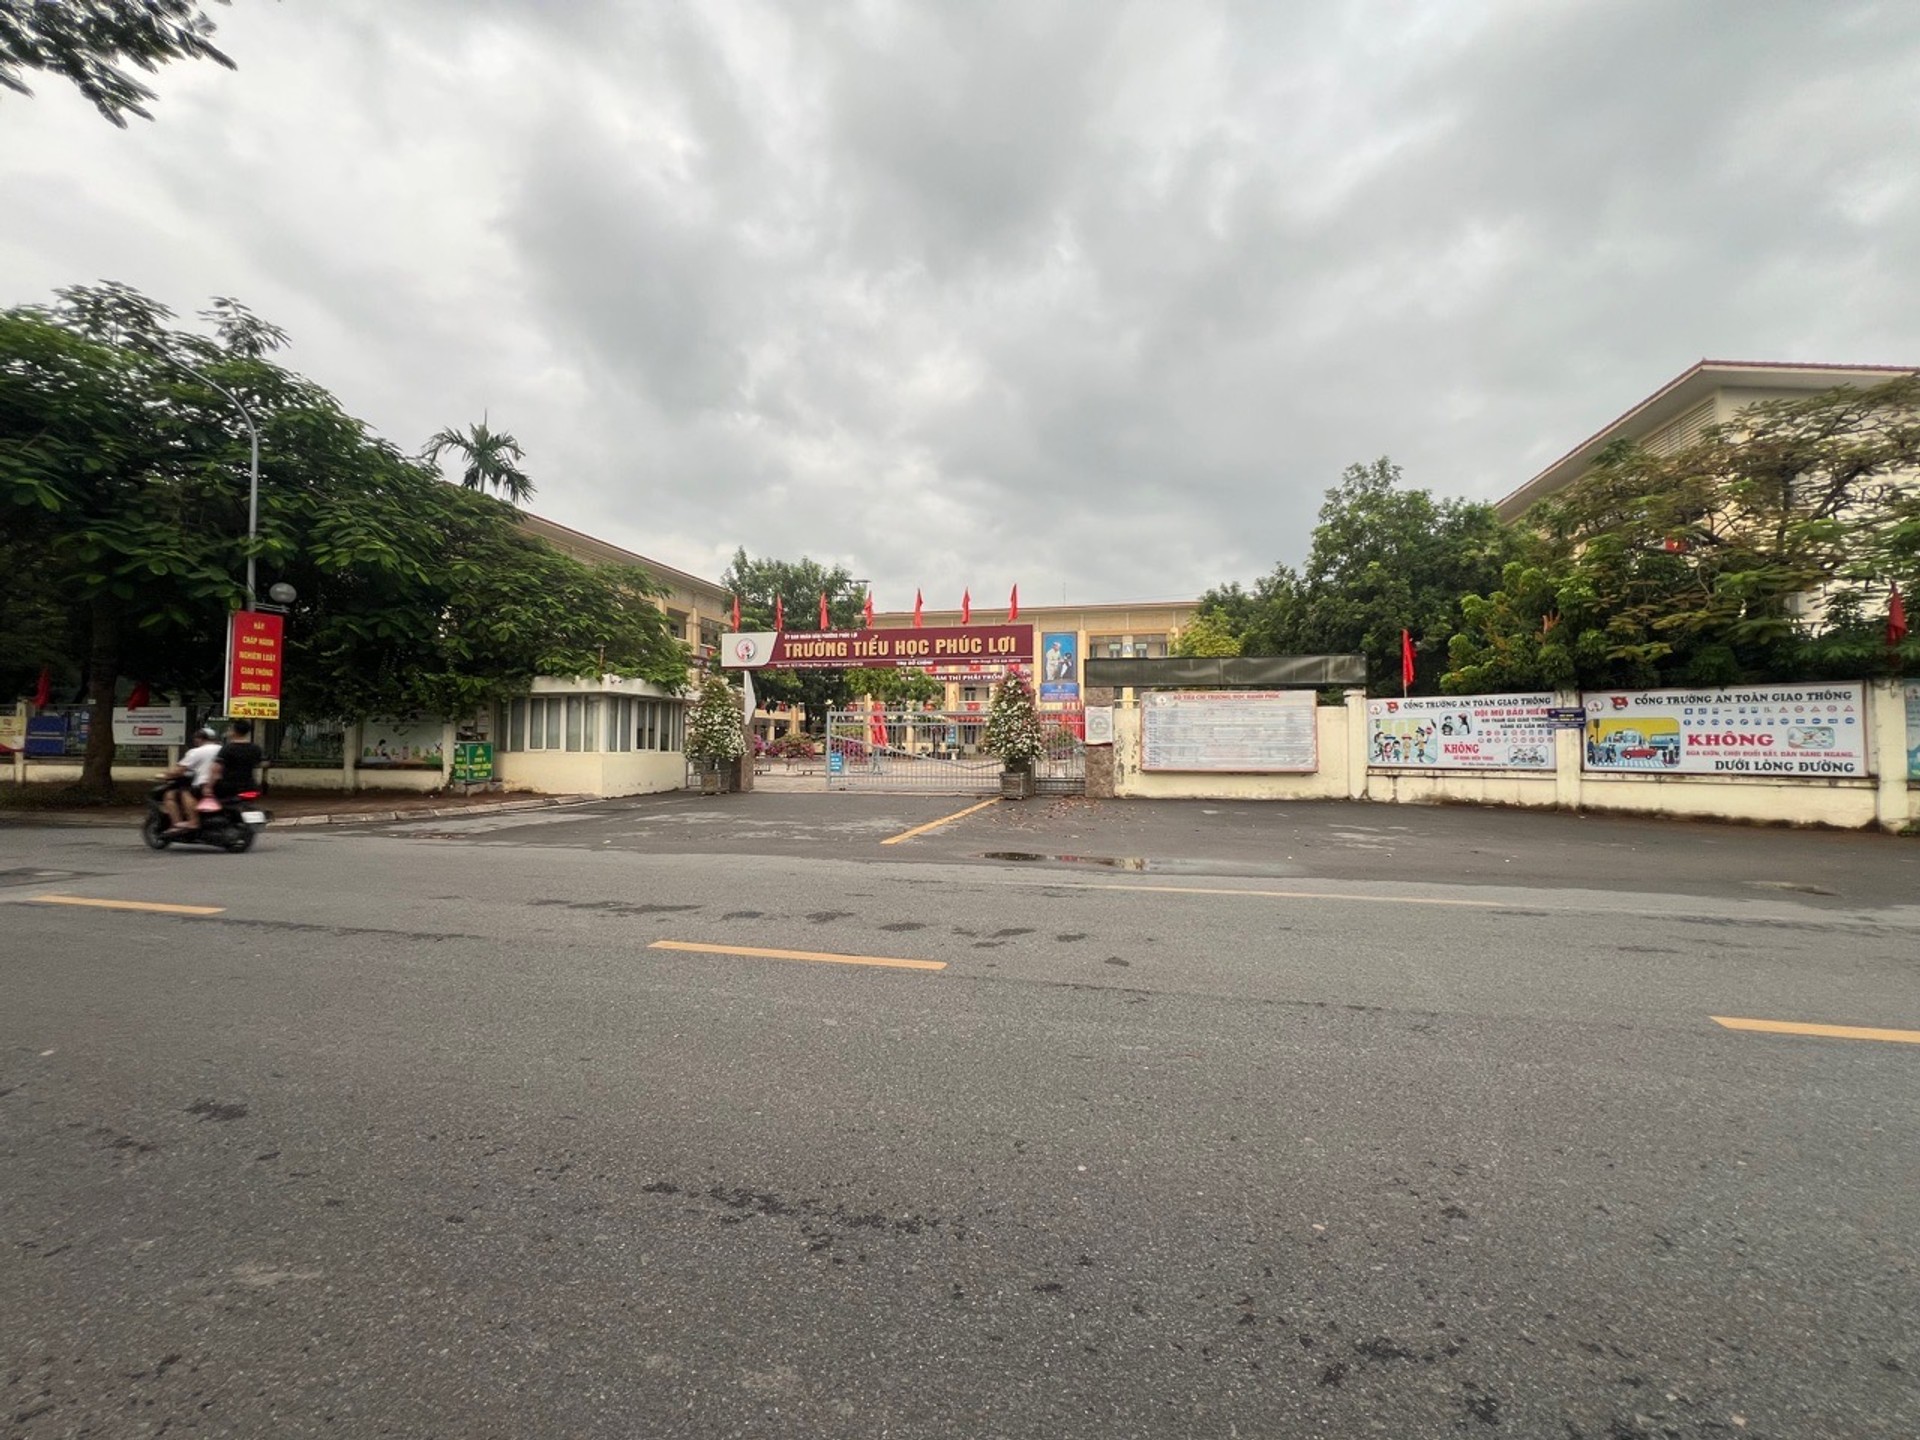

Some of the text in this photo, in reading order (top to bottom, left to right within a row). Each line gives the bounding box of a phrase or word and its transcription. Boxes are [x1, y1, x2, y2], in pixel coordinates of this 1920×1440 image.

[784, 634, 1016, 659] TRƯỜNG TIỂU HỌC PHÚC LỢI
[1425, 699, 1458, 709] TRƯỜNG
[1460, 700, 1471, 708] AN
[1472, 697, 1496, 707] TOÀN
[1497, 698, 1519, 707] GIAO
[1520, 696, 1552, 706] THÔNG
[1635, 689, 1853, 705] CỔNG TRƯỜNG AN TOÀN GIAO THÔNG
[1506, 706, 1524, 716] BẢO
[1687, 730, 1775, 747] KHÔNG
[1443, 740, 1480, 754] KHÔNG
[1715, 758, 1856, 773] DƯỚI LÒNG ĐƯỜNG
